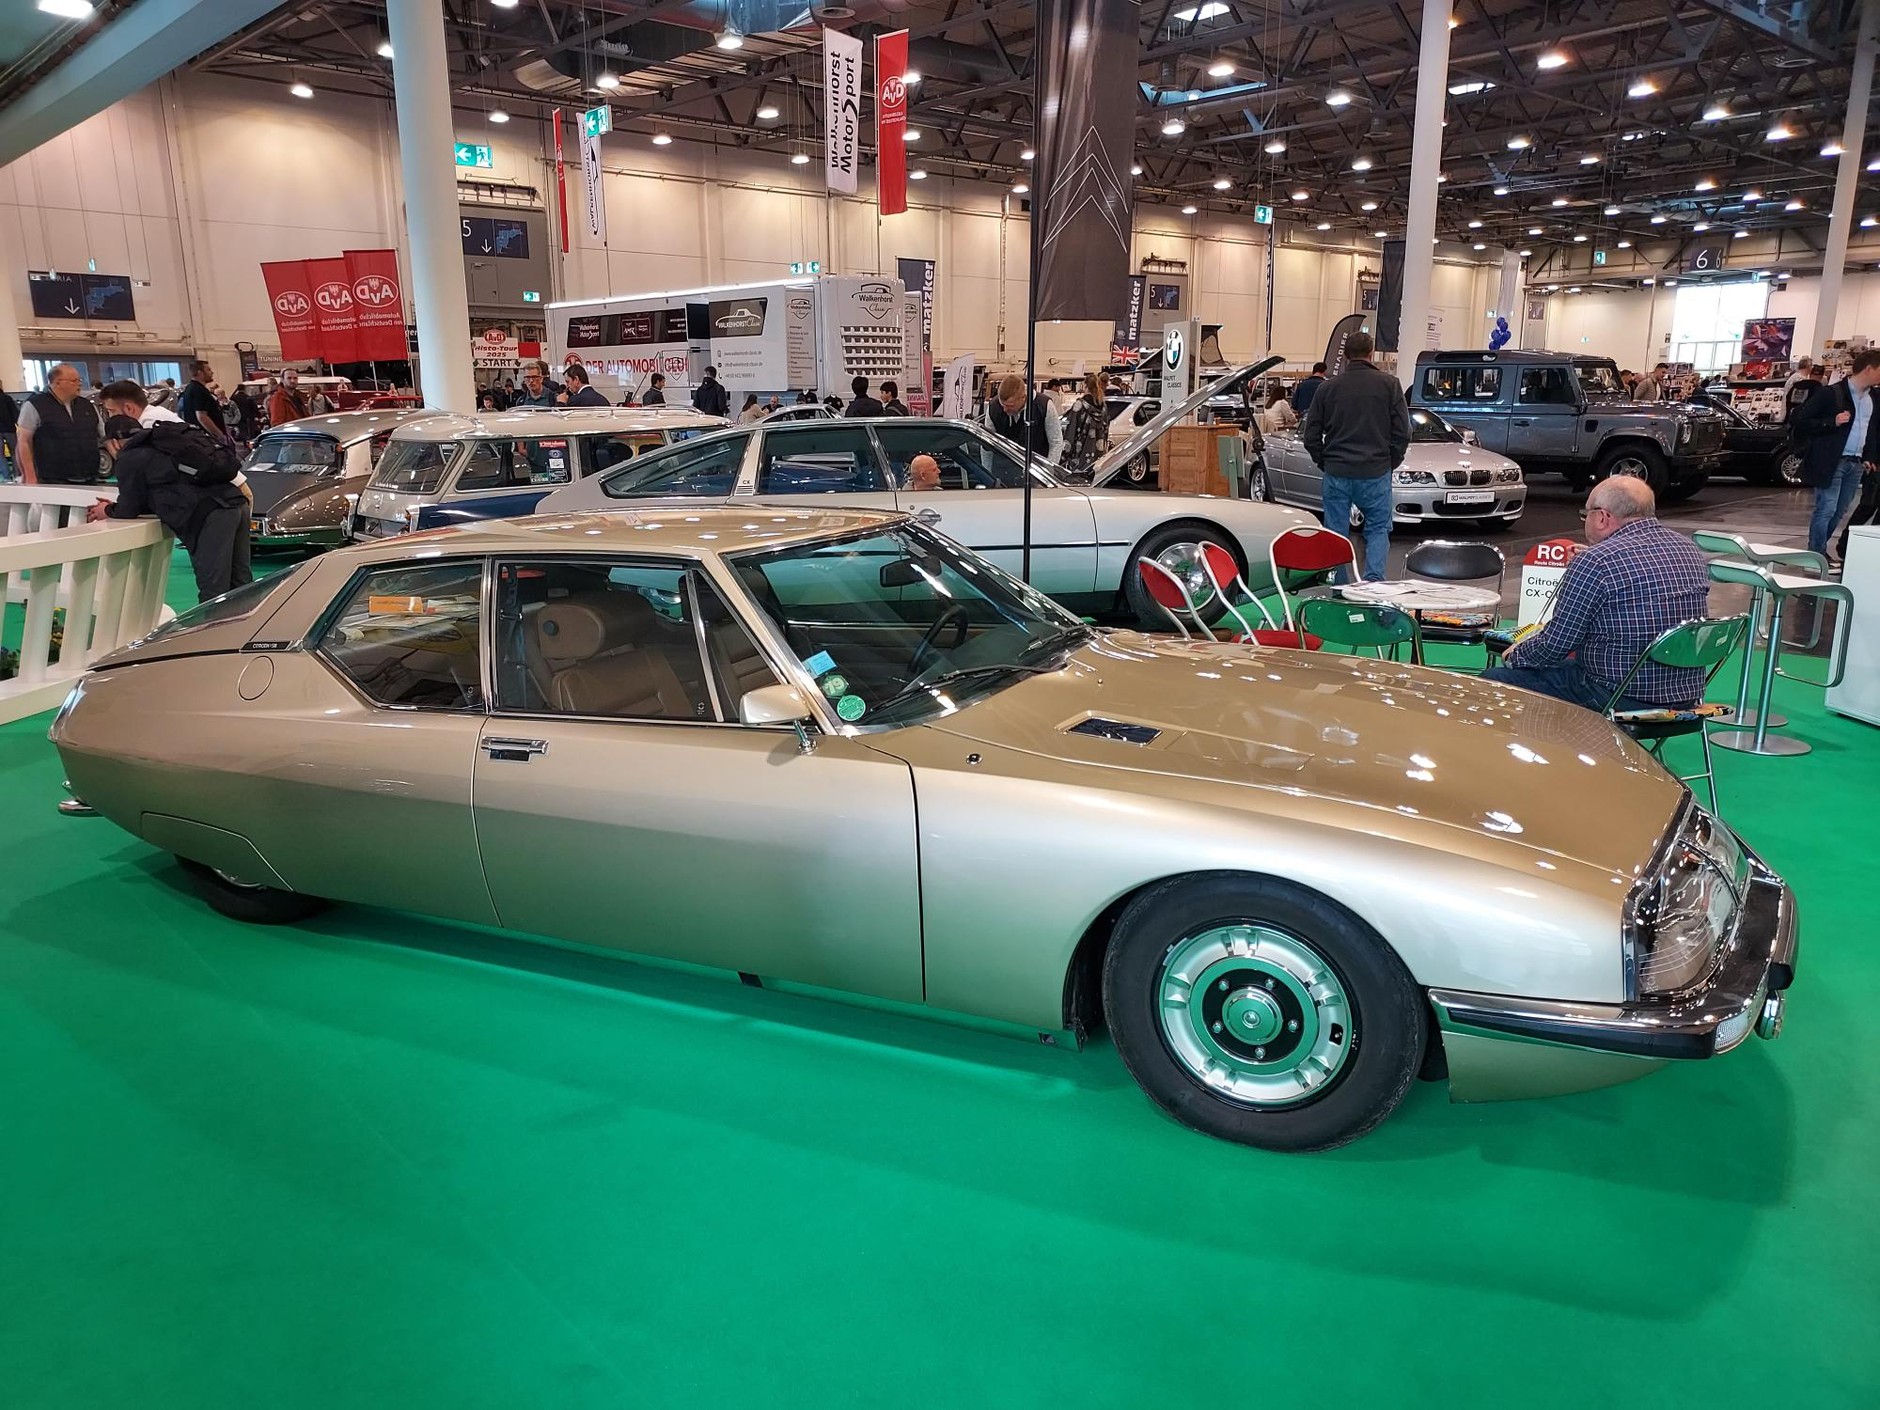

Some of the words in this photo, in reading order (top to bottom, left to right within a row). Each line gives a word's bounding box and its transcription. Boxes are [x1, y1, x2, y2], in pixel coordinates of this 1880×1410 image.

[462, 219, 472, 237] 5
[1696, 249, 1708, 269] 6
[1715, 249, 1722, 269] 6
[859, 294, 893, 303] Walkenhorst
[922, 262, 934, 335] matzker
[1150, 285, 1156, 298] 5
[1129, 280, 1141, 341] matzker
[1332, 332, 1348, 376] ENADIER
[482, 359, 512, 367] START
[585, 360, 605, 374] DER
[1537, 544, 1565, 560] RC
[1527, 576, 1559, 587] Citroë
